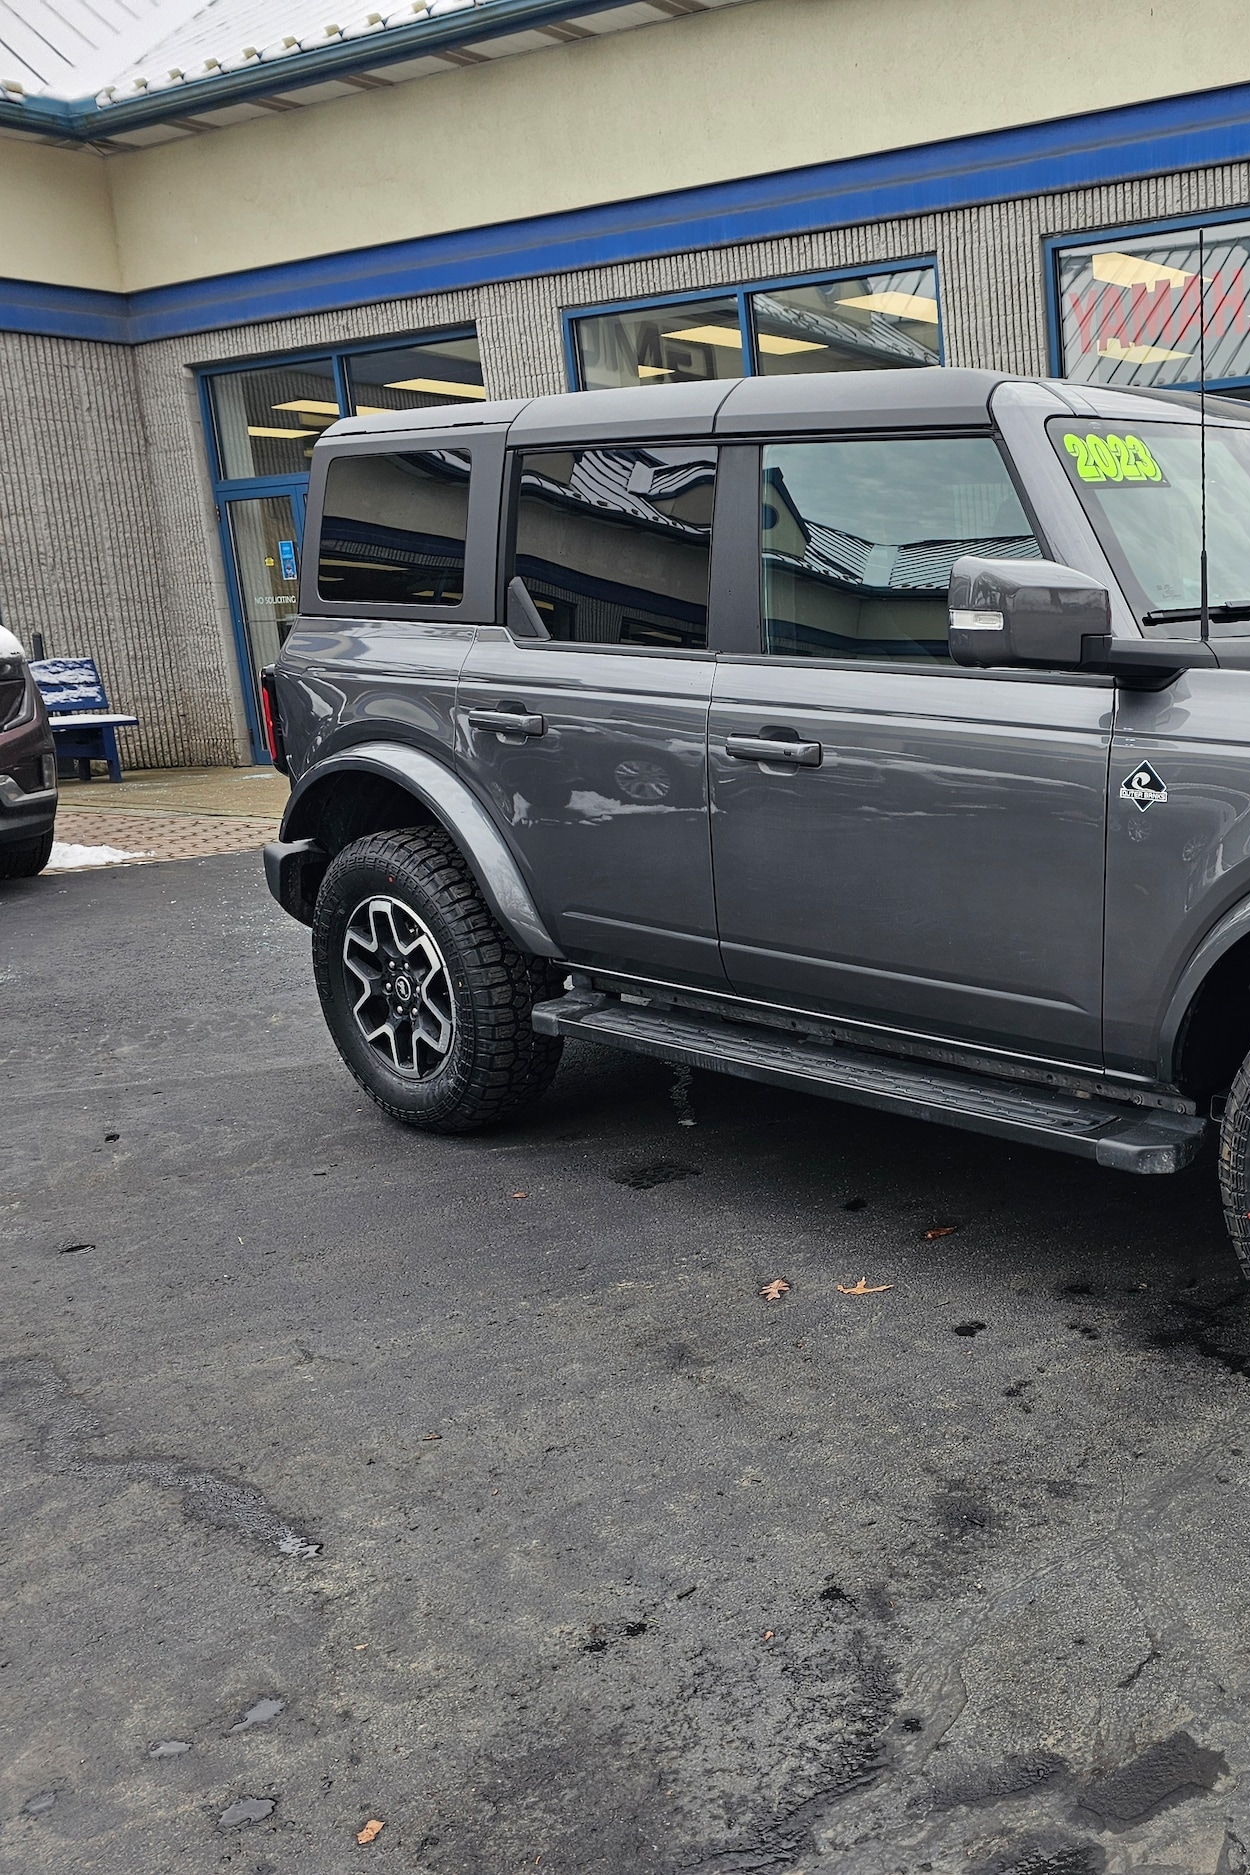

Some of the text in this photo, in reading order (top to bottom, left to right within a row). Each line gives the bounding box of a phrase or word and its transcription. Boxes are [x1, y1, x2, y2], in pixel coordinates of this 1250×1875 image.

[1063, 433, 1162, 482] 2023
[265, 596, 297, 604] SOLICITING
[1122, 790, 1166, 800] OUTER BANKS
